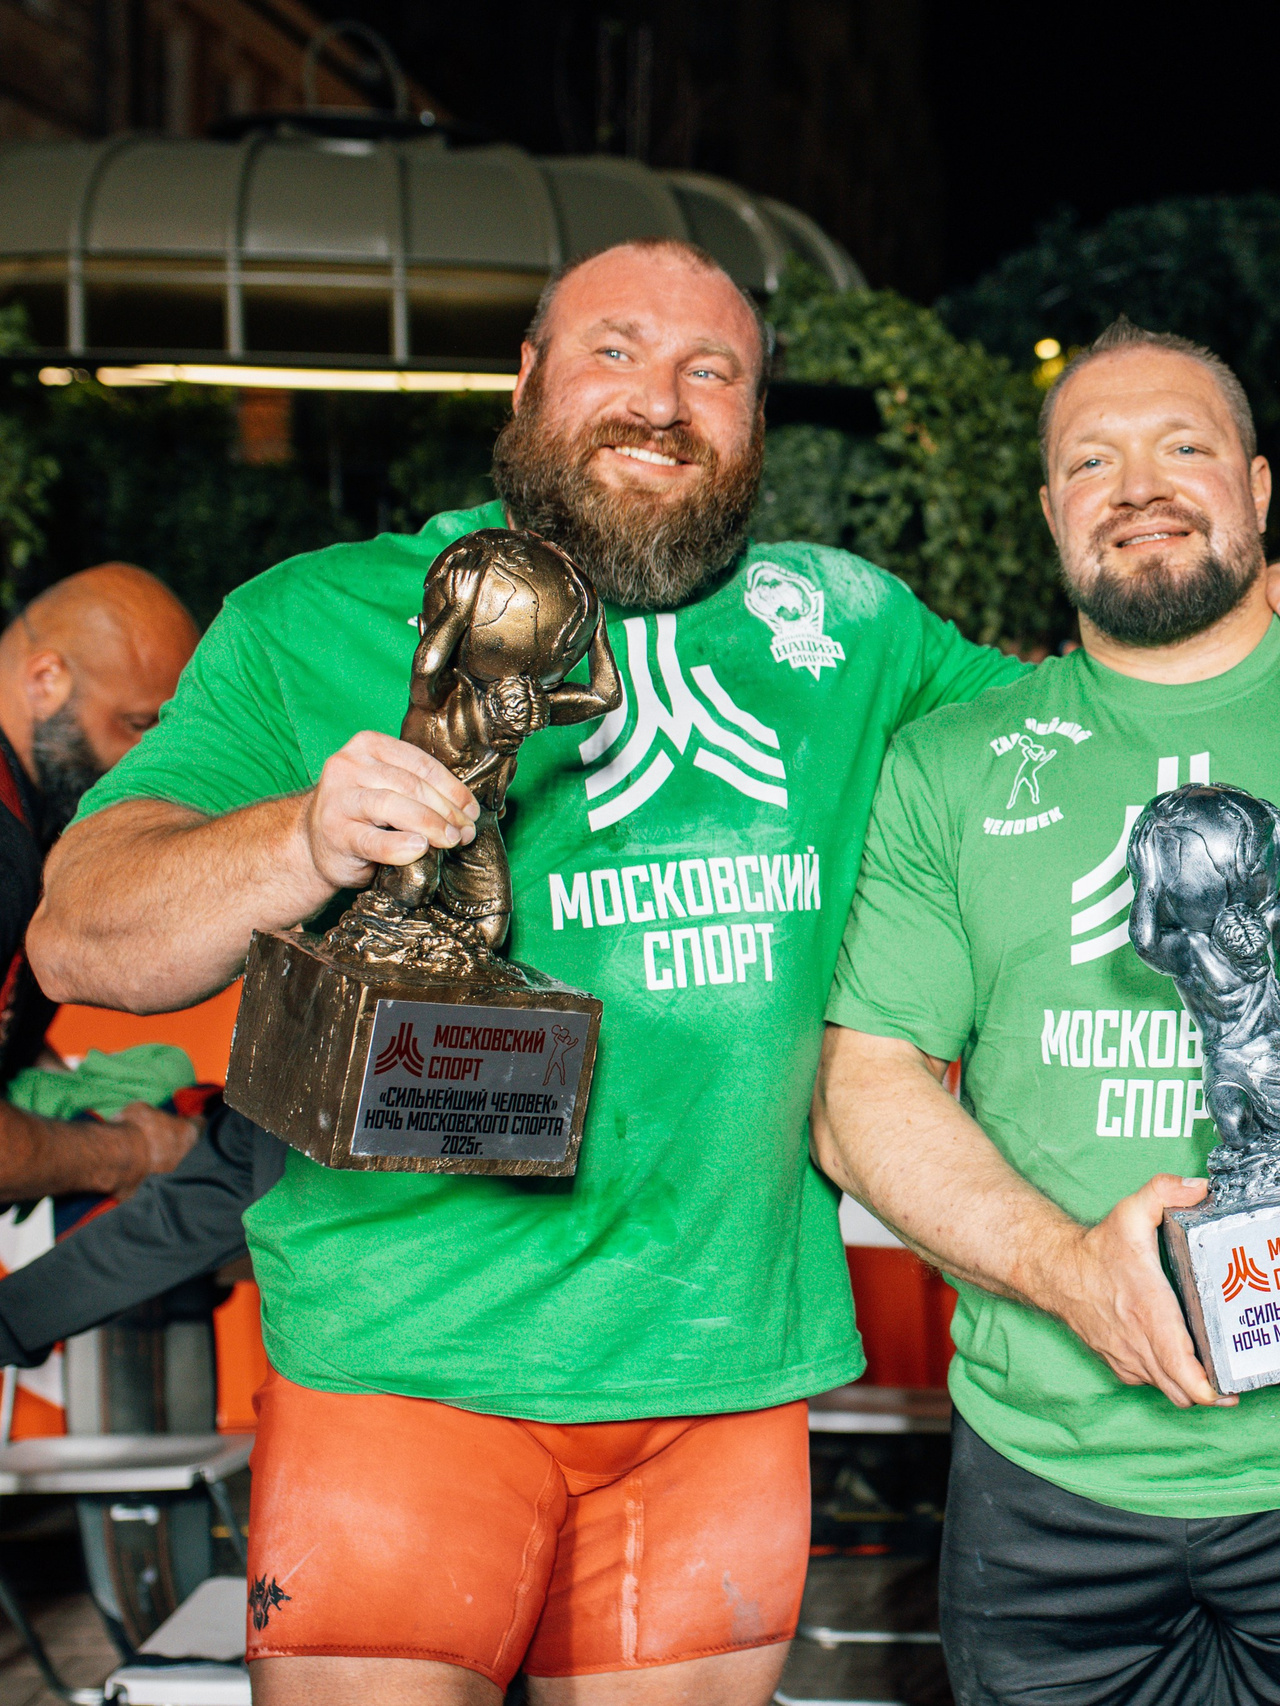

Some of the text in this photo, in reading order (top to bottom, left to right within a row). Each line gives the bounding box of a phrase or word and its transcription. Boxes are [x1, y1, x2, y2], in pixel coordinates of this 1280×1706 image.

[775, 640, 840, 657] НАЦИЯ
[792, 654, 831, 664] МИРА
[983, 806, 1064, 836] ЧЕЛОВЕК
[549, 846, 821, 931] МОСКОВСКИЙ
[643, 923, 775, 991] СПОРТ
[433, 1024, 546, 1054] МОСКОВСКИЙ
[427, 1056, 484, 1081] СПОРТ
[379, 1086, 558, 1114] «СИЛЬНЕЙШИЙ ЧЕЛОВЕК»
[1096, 1079, 1211, 1138] СПОР
[364, 1109, 564, 1137] НОЧЬ МОСКОВСКОГО СПОРТА
[440, 1135, 484, 1156] 2025г.
[1232, 1329, 1271, 1353] НОЧЬ
